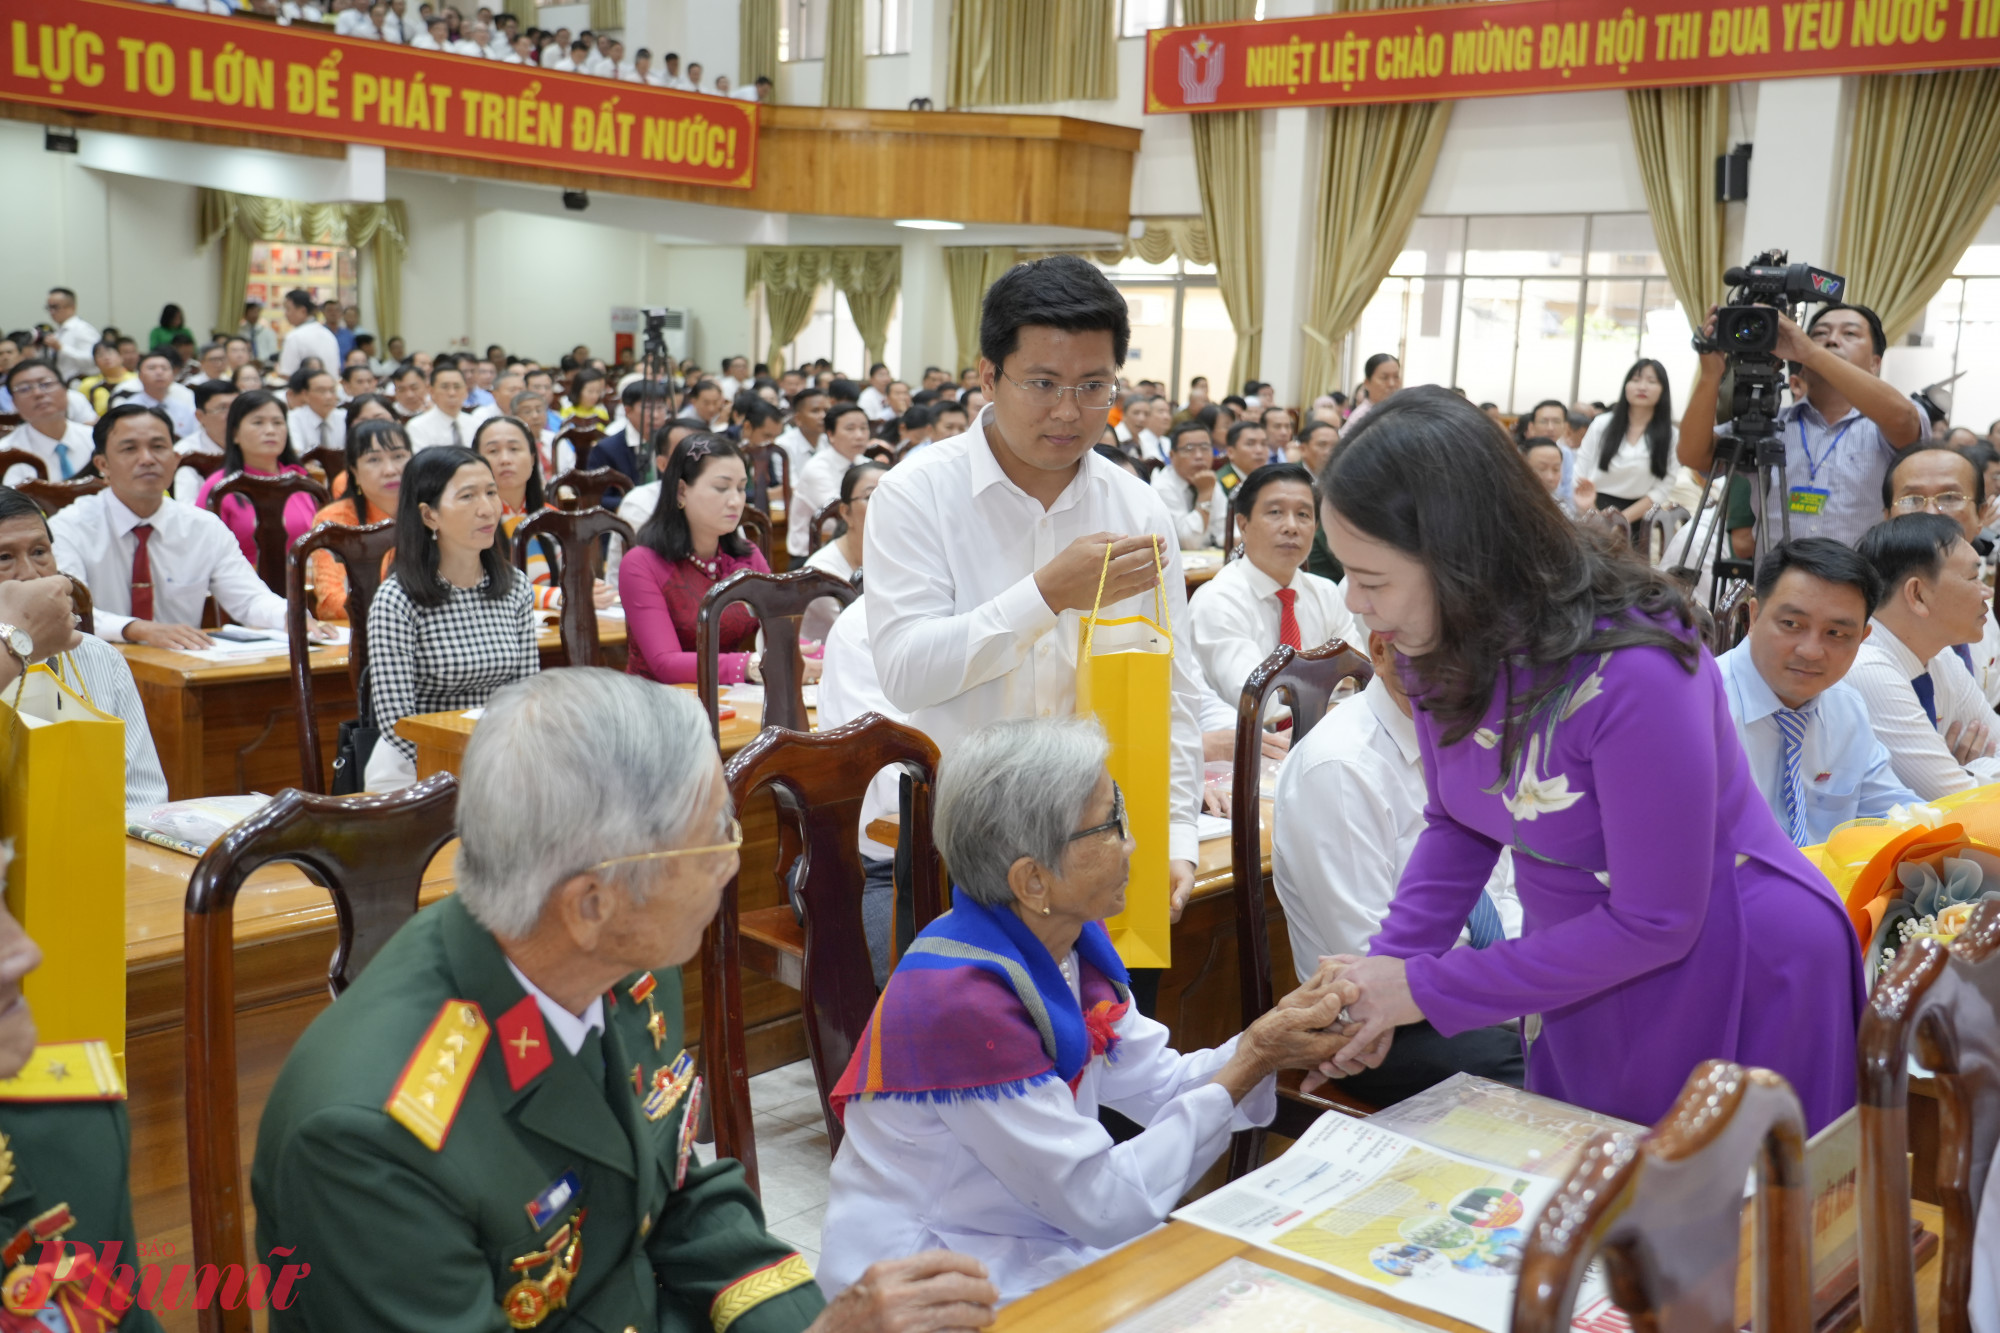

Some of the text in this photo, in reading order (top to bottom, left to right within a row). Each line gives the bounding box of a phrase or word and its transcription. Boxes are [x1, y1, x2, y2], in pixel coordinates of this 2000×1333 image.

[11, 19, 737, 169] LỰC TO LỚN ĐỂ PHÁT TRIỂN ĐẤT NƯỚC!
[1245, 35, 1314, 95] NHIỆT
[1319, 31, 1371, 92] LIỆT
[1375, 25, 1446, 81] CHÀO
[1450, 20, 1533, 75] MỪNG
[1540, 21, 1590, 78] ĐẠI
[1595, 8, 1647, 75] HỘI
[1655, 12, 1702, 62] THI
[1708, 5, 1771, 58] ĐUA
[1811, 272, 1840, 295] VTV
